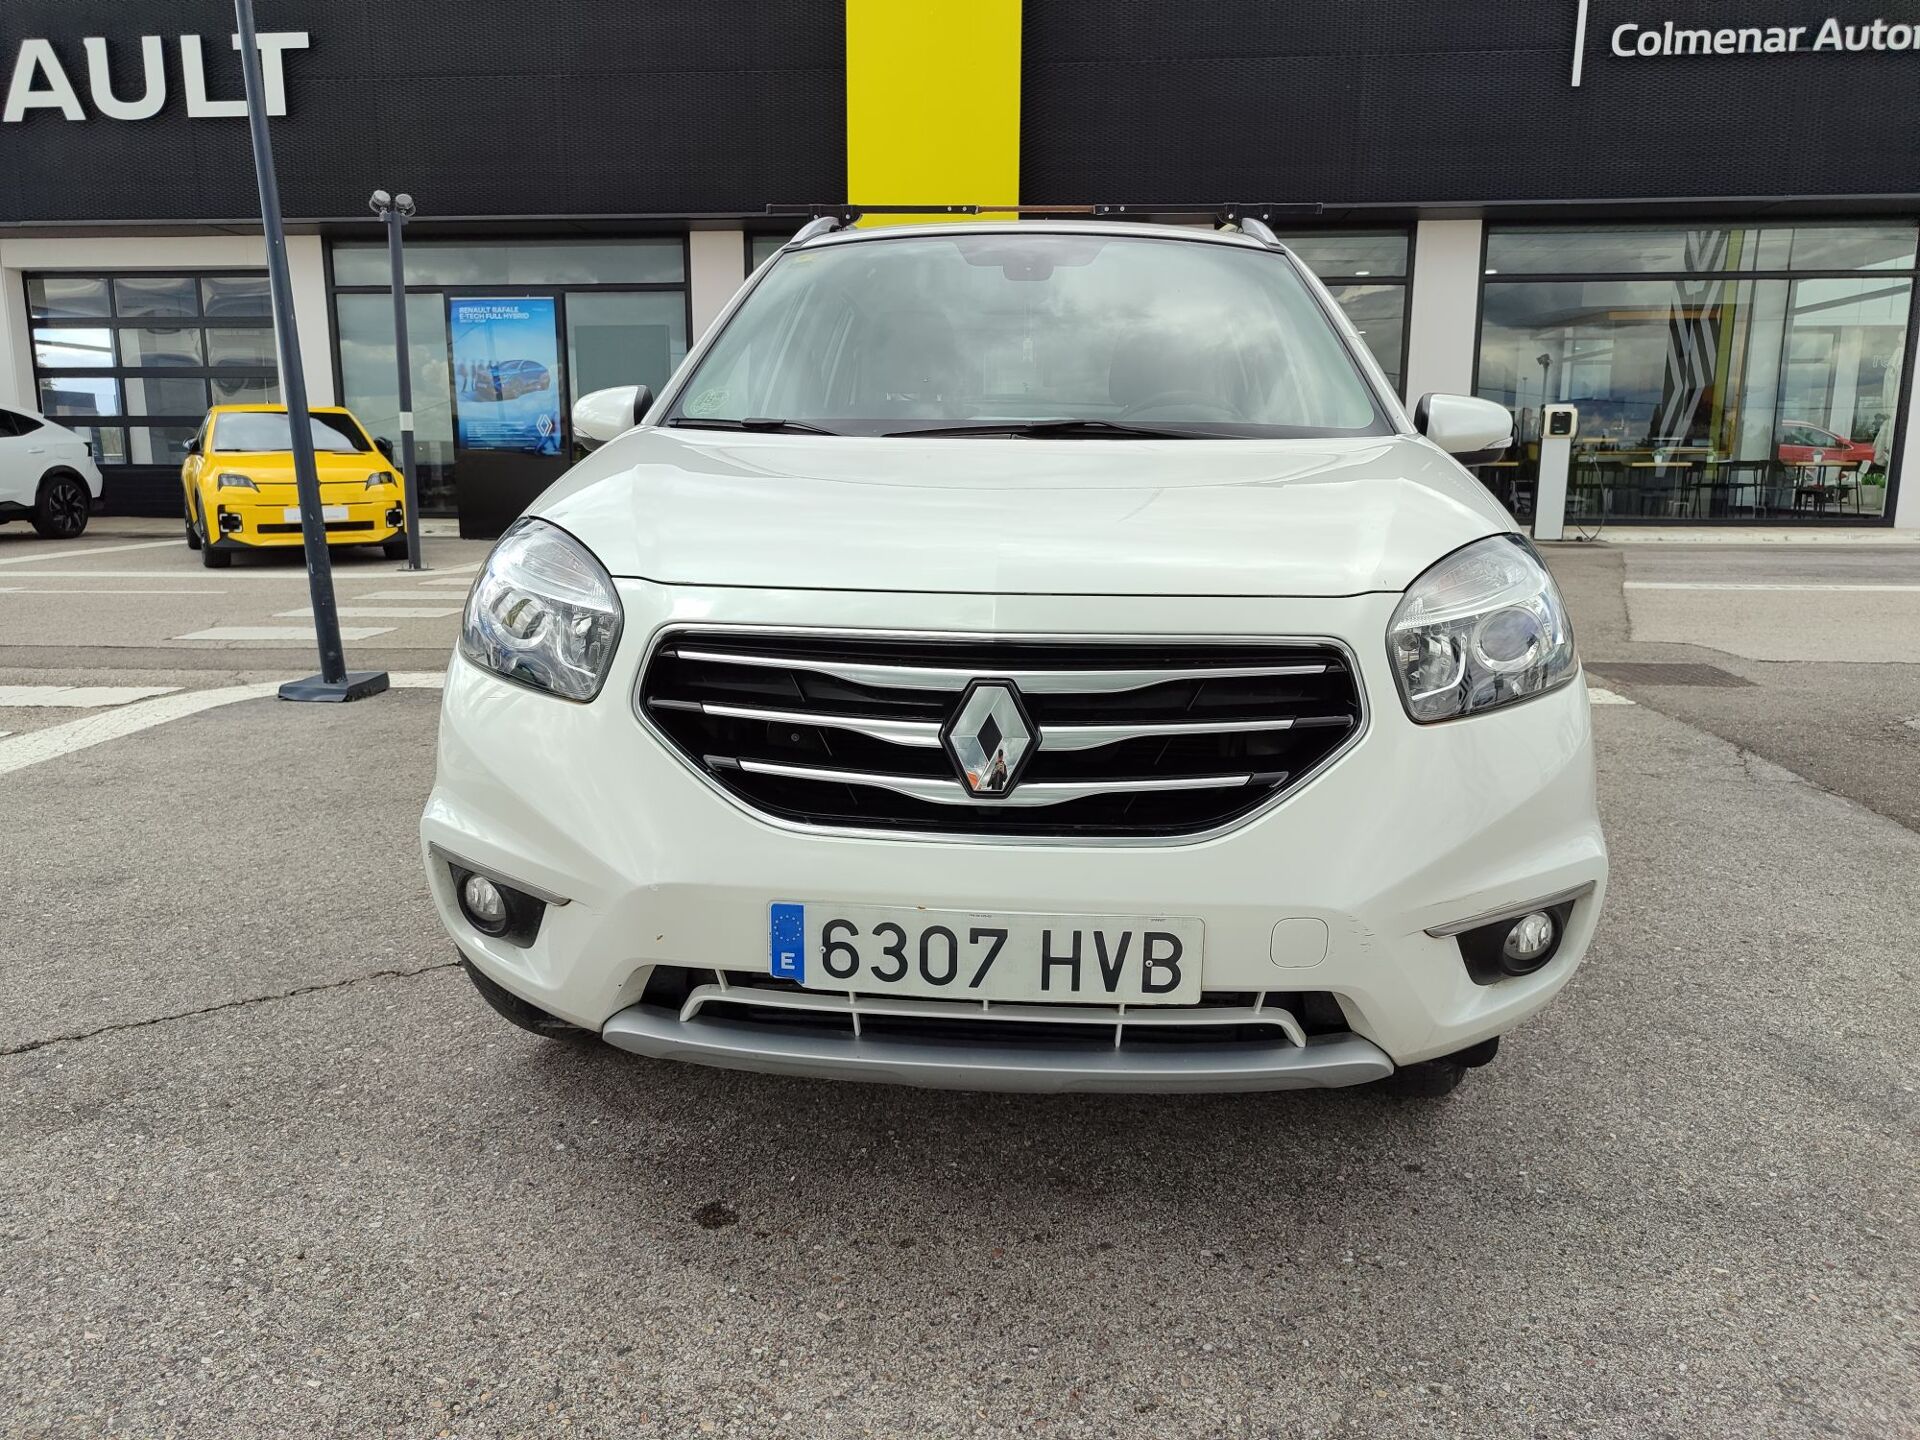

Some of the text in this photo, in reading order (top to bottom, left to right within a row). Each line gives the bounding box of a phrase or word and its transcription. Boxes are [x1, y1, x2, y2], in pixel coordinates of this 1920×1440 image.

[1610, 21, 1807, 57] Colmenar
[2, 31, 309, 123] AULT
[780, 952, 795, 970] E
[821, 919, 1183, 994] 6307 HVB
